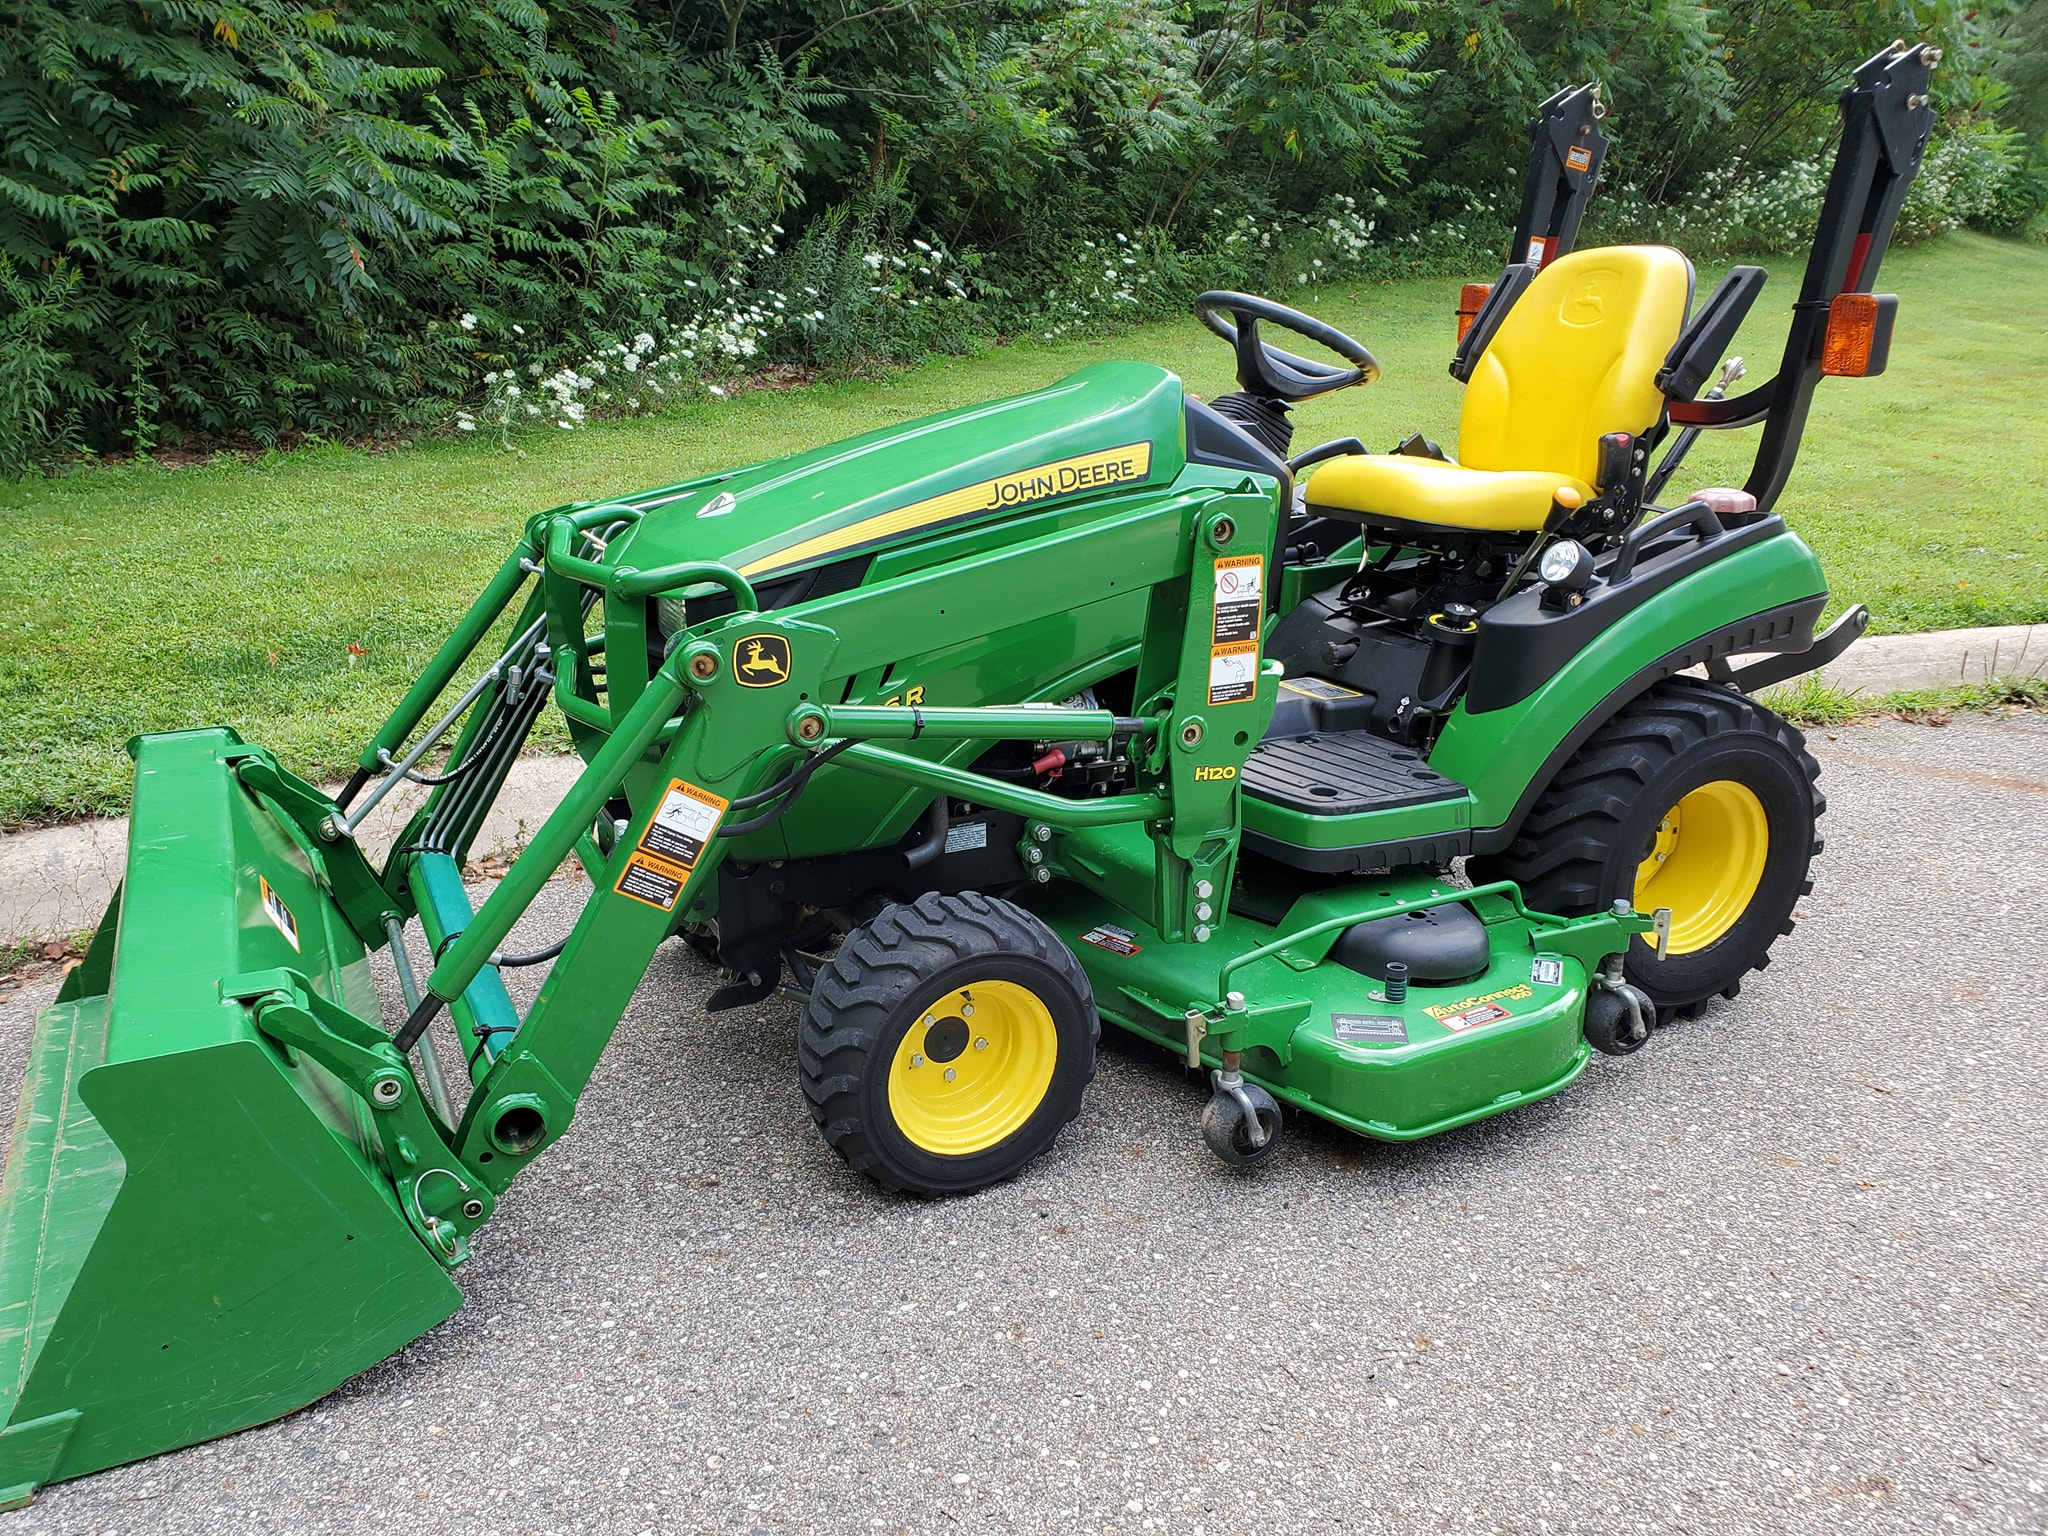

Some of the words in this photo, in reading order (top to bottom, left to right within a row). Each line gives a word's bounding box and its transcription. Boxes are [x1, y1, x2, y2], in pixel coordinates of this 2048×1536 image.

[987, 475, 1053, 506] JOHN
[1058, 459, 1135, 489] DEERE
[1223, 557, 1260, 568] WARNING
[1220, 644, 1256, 655] WARNING
[1194, 765, 1237, 782] H120
[686, 787, 722, 807] WARNING
[647, 860, 684, 880] WARNING
[1431, 983, 1532, 1018] AutoConnect
